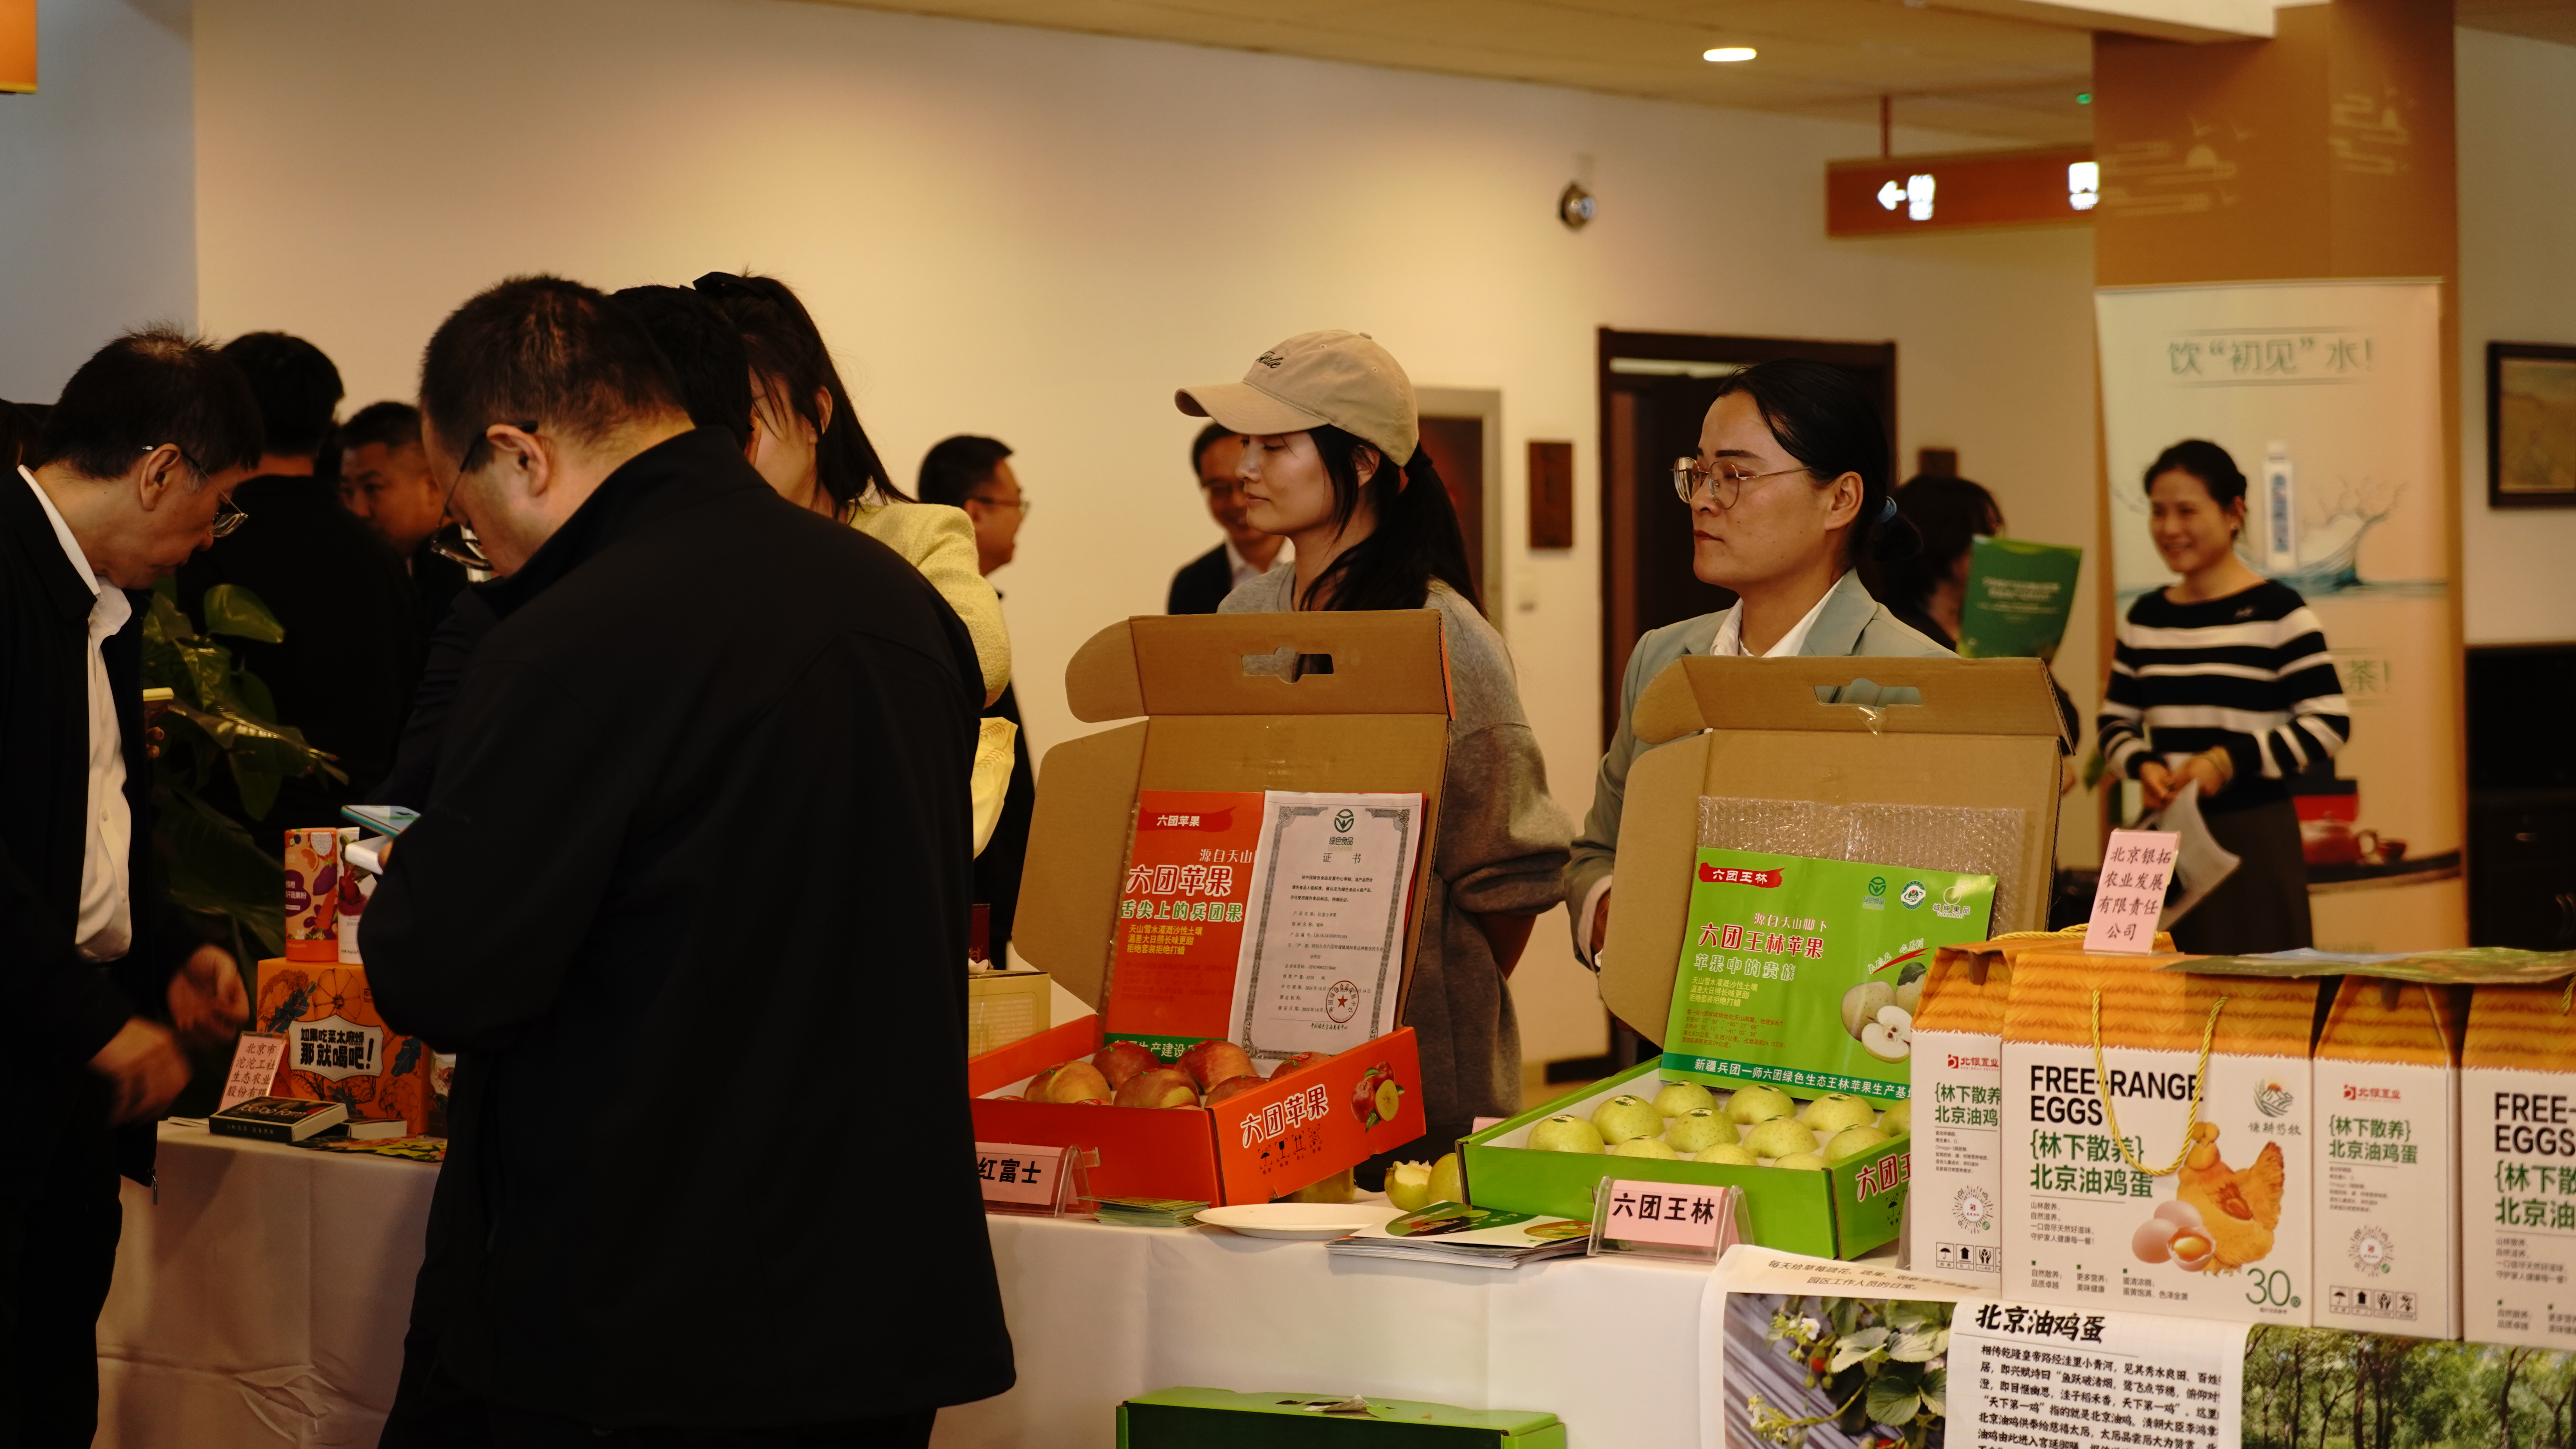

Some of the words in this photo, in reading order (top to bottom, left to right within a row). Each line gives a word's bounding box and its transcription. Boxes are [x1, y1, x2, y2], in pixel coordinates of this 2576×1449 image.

[1157, 815, 1200, 827] 六团苹果
[1328, 837, 1353, 846] 绿色食品
[1199, 849, 1256, 864] 源自天山
[1322, 852, 1332, 863] 证
[1352, 853, 1361, 864] 书
[2111, 846, 2172, 865] 北京银拓
[1125, 864, 1232, 897] 六团苹果
[1713, 869, 1768, 885] 六团王林
[2104, 871, 2163, 891] 农业发展
[1121, 899, 1243, 922] 舌尖上的兵团果
[2097, 897, 2158, 915] 有限责任
[1129, 924, 1203, 936] 天山雪水灌溉沙性土壤
[1753, 912, 1829, 933] 源自天山脚下
[2106, 923, 2137, 940] 公司
[1127, 944, 1185, 955] 拒绝套装拒绝打蜡
[1128, 934, 1194, 945] 温差大日照长味更甜
[1698, 922, 1824, 959] 六团王林苹果
[1694, 953, 1796, 982] 苹果中的贵族
[301, 1028, 364, 1044] 如果吃菜太麻烦
[246, 1043, 276, 1056] 北京市
[301, 1038, 374, 1070] 那就喝吧!
[1960, 1056, 1999, 1067] 北银置业
[231, 1070, 270, 1085] 生态农业
[2031, 1065, 2203, 1101] FREE-RANGE
[1240, 1083, 1329, 1149] 六团苹果
[2031, 1095, 2102, 1126] EGGS
[2329, 1115, 2411, 1141] {林下散养}
[2030, 1128, 2144, 1164] {林下散养}
[2495, 1125, 2575, 1157] EGGS
[2329, 1140, 2417, 1164] 北京油鸡蛋
[978, 1157, 1041, 1184] 红富士
[2030, 1163, 2153, 1198] 北京油鸡蛋
[1612, 1193, 1715, 1225] 六团王林
[2495, 1197, 2575, 1229] 北京油
[2031, 1279, 2059, 1289] 品质卓越
[2077, 1284, 2105, 1294] 美味健康
[1975, 1304, 2106, 1344] 北京油鸡蛋
[1981, 1344, 2221, 1385] 相传乾隆皇帝路经洼里小青河,见其秀水良田、百姓
